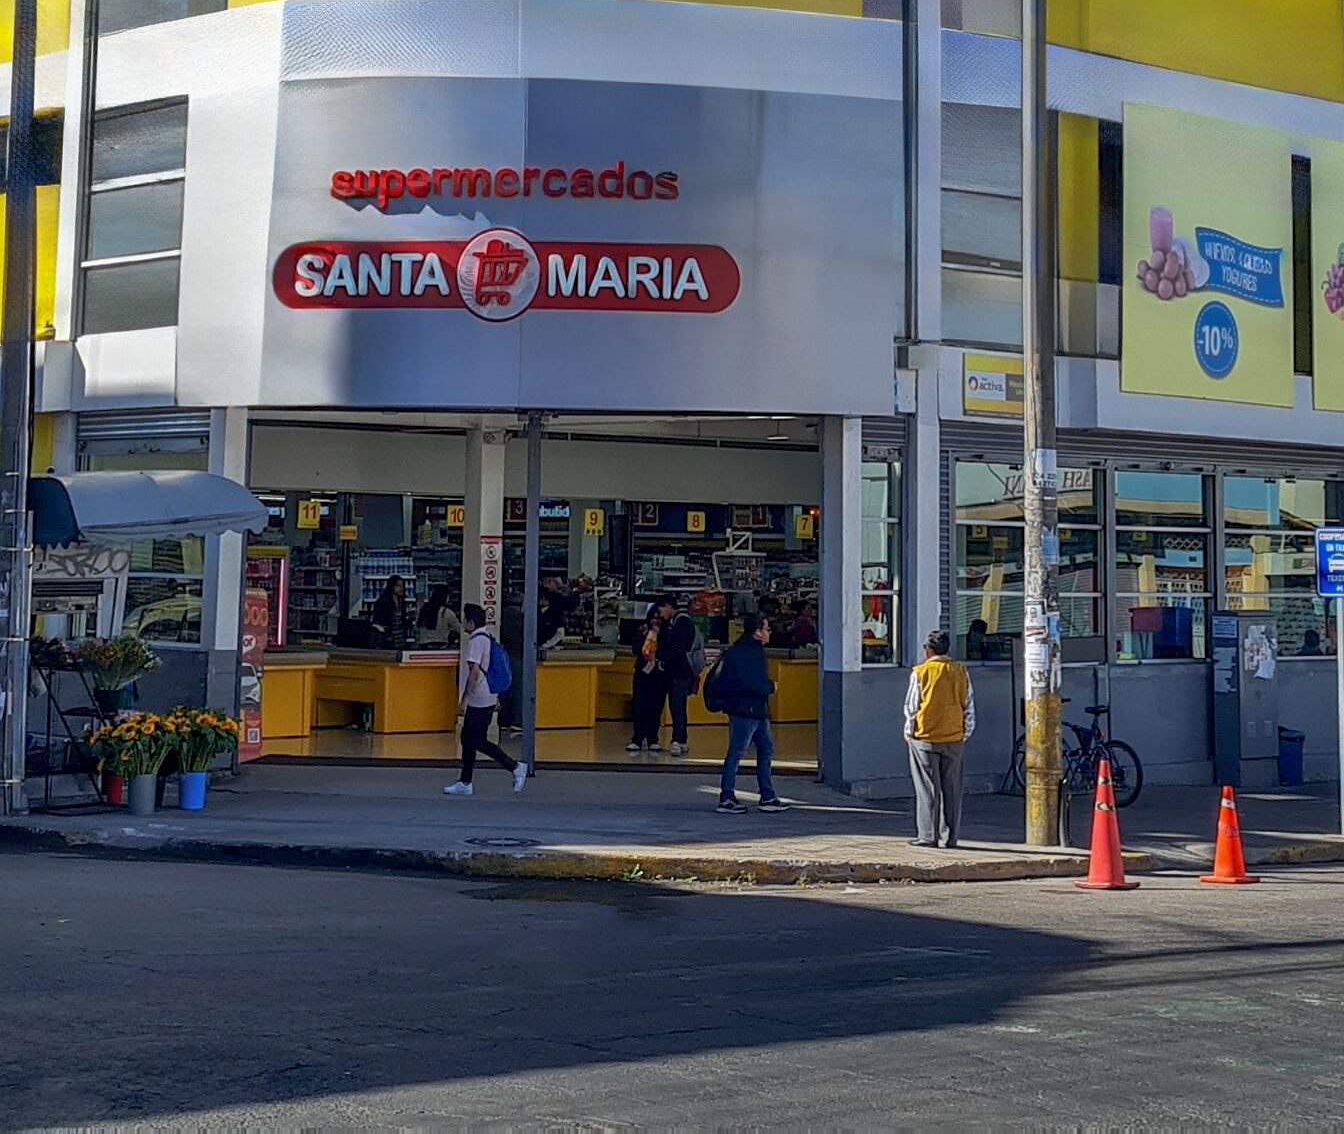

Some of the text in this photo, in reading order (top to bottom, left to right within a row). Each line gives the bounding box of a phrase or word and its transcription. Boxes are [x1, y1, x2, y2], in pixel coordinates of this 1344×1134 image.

[330, 161, 679, 210] supermercados
[293, 251, 710, 302] SANTA MARIA
[1197, 324, 1233, 356] -10%
[302, 503, 318, 520] 11
[515, 500, 524, 515] 3
[645, 503, 655, 517] 2
[450, 508, 465, 523] 10
[589, 511, 598, 526] 9
[691, 513, 700, 529] 8
[801, 516, 808, 530] 7
